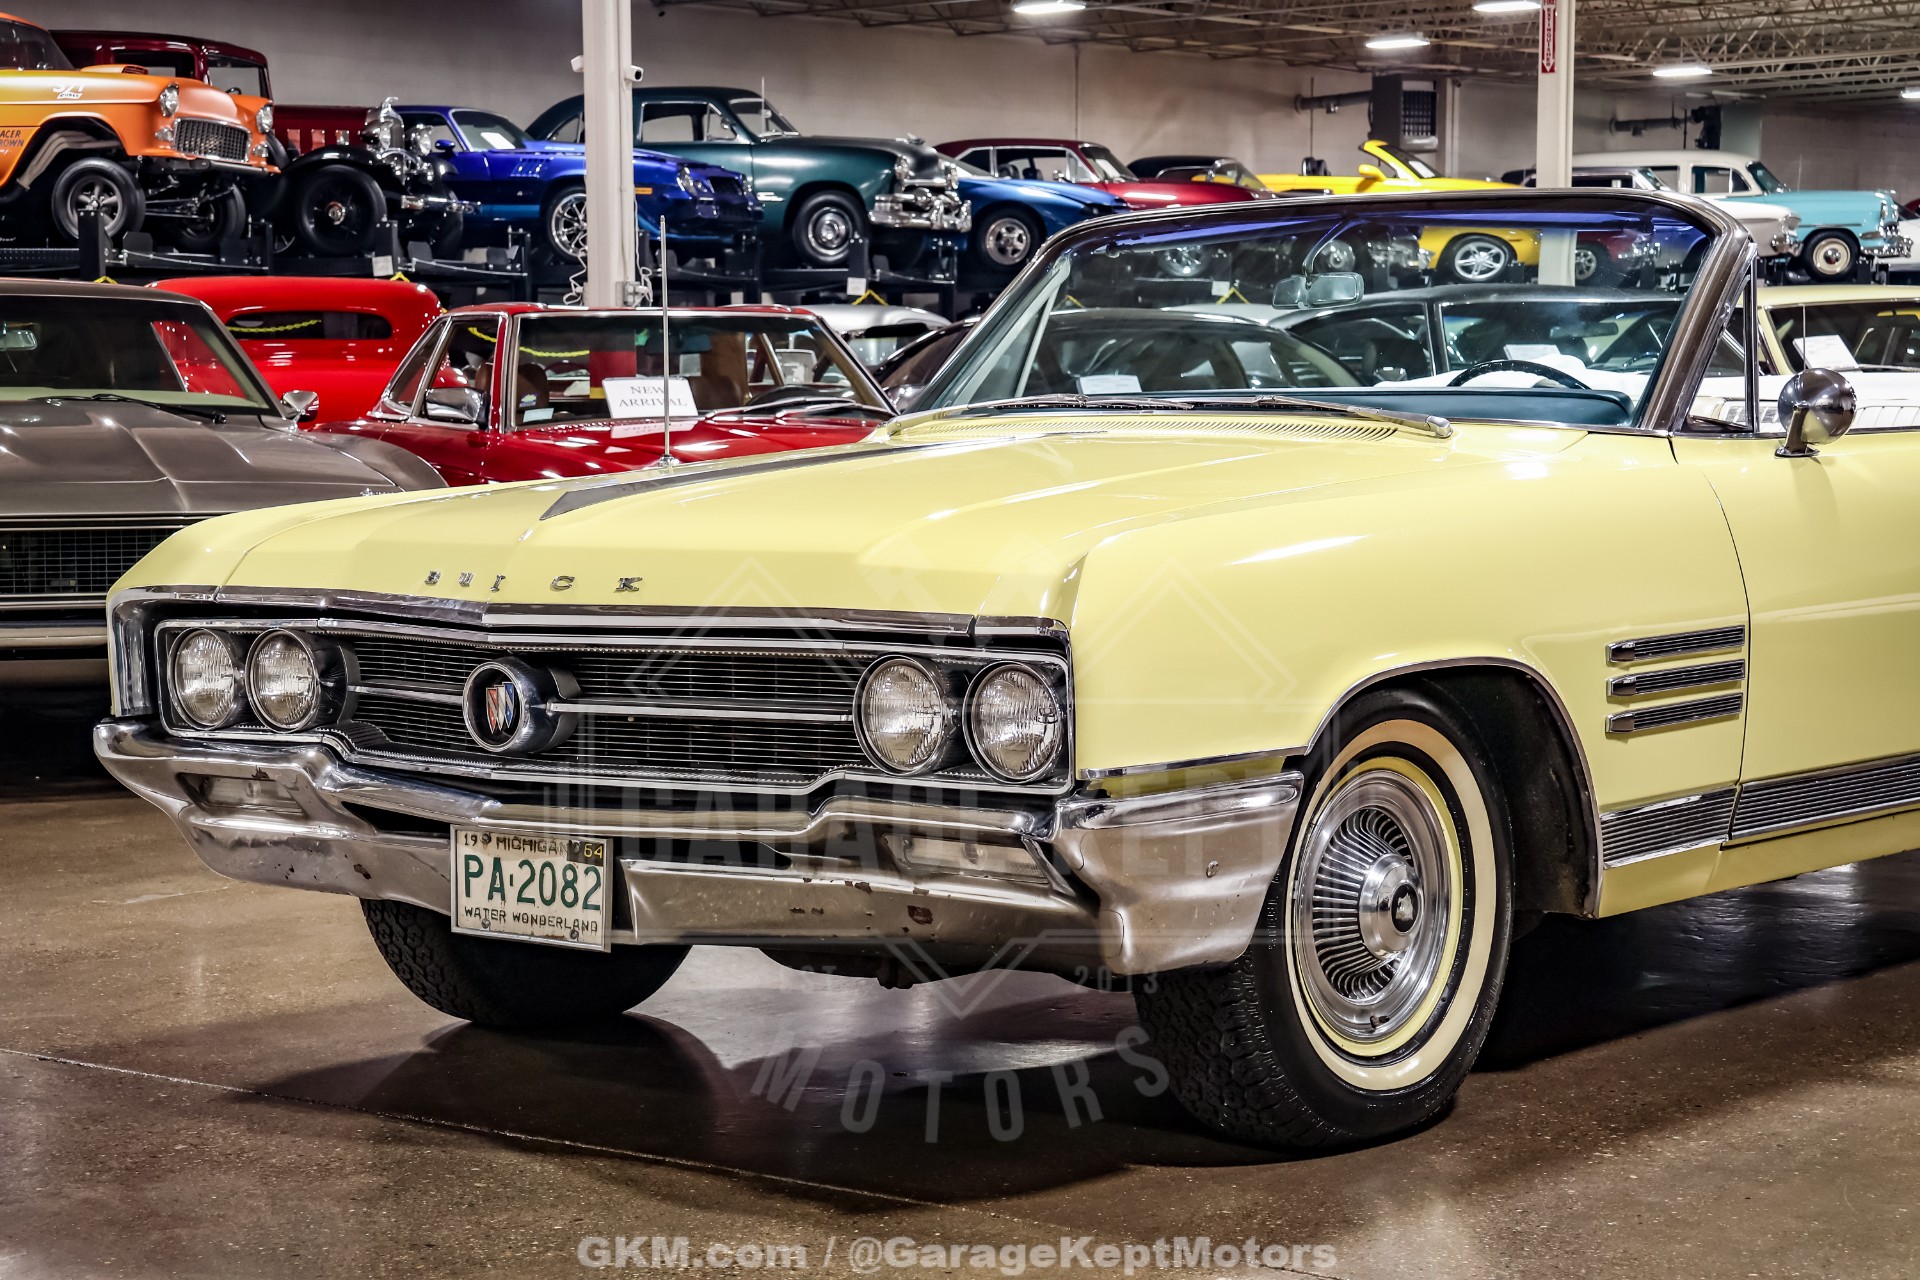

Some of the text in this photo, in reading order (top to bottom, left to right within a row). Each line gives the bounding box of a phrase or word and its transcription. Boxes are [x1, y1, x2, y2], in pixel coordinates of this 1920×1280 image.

[630, 386, 667, 394] NEW
[618, 398, 688, 407] ARRIVAL
[424, 570, 643, 593] BUICK
[496, 835, 568, 855] MICHIGAN
[583, 843, 604, 859] 64
[464, 906, 598, 933] WATER WONDERLAND
